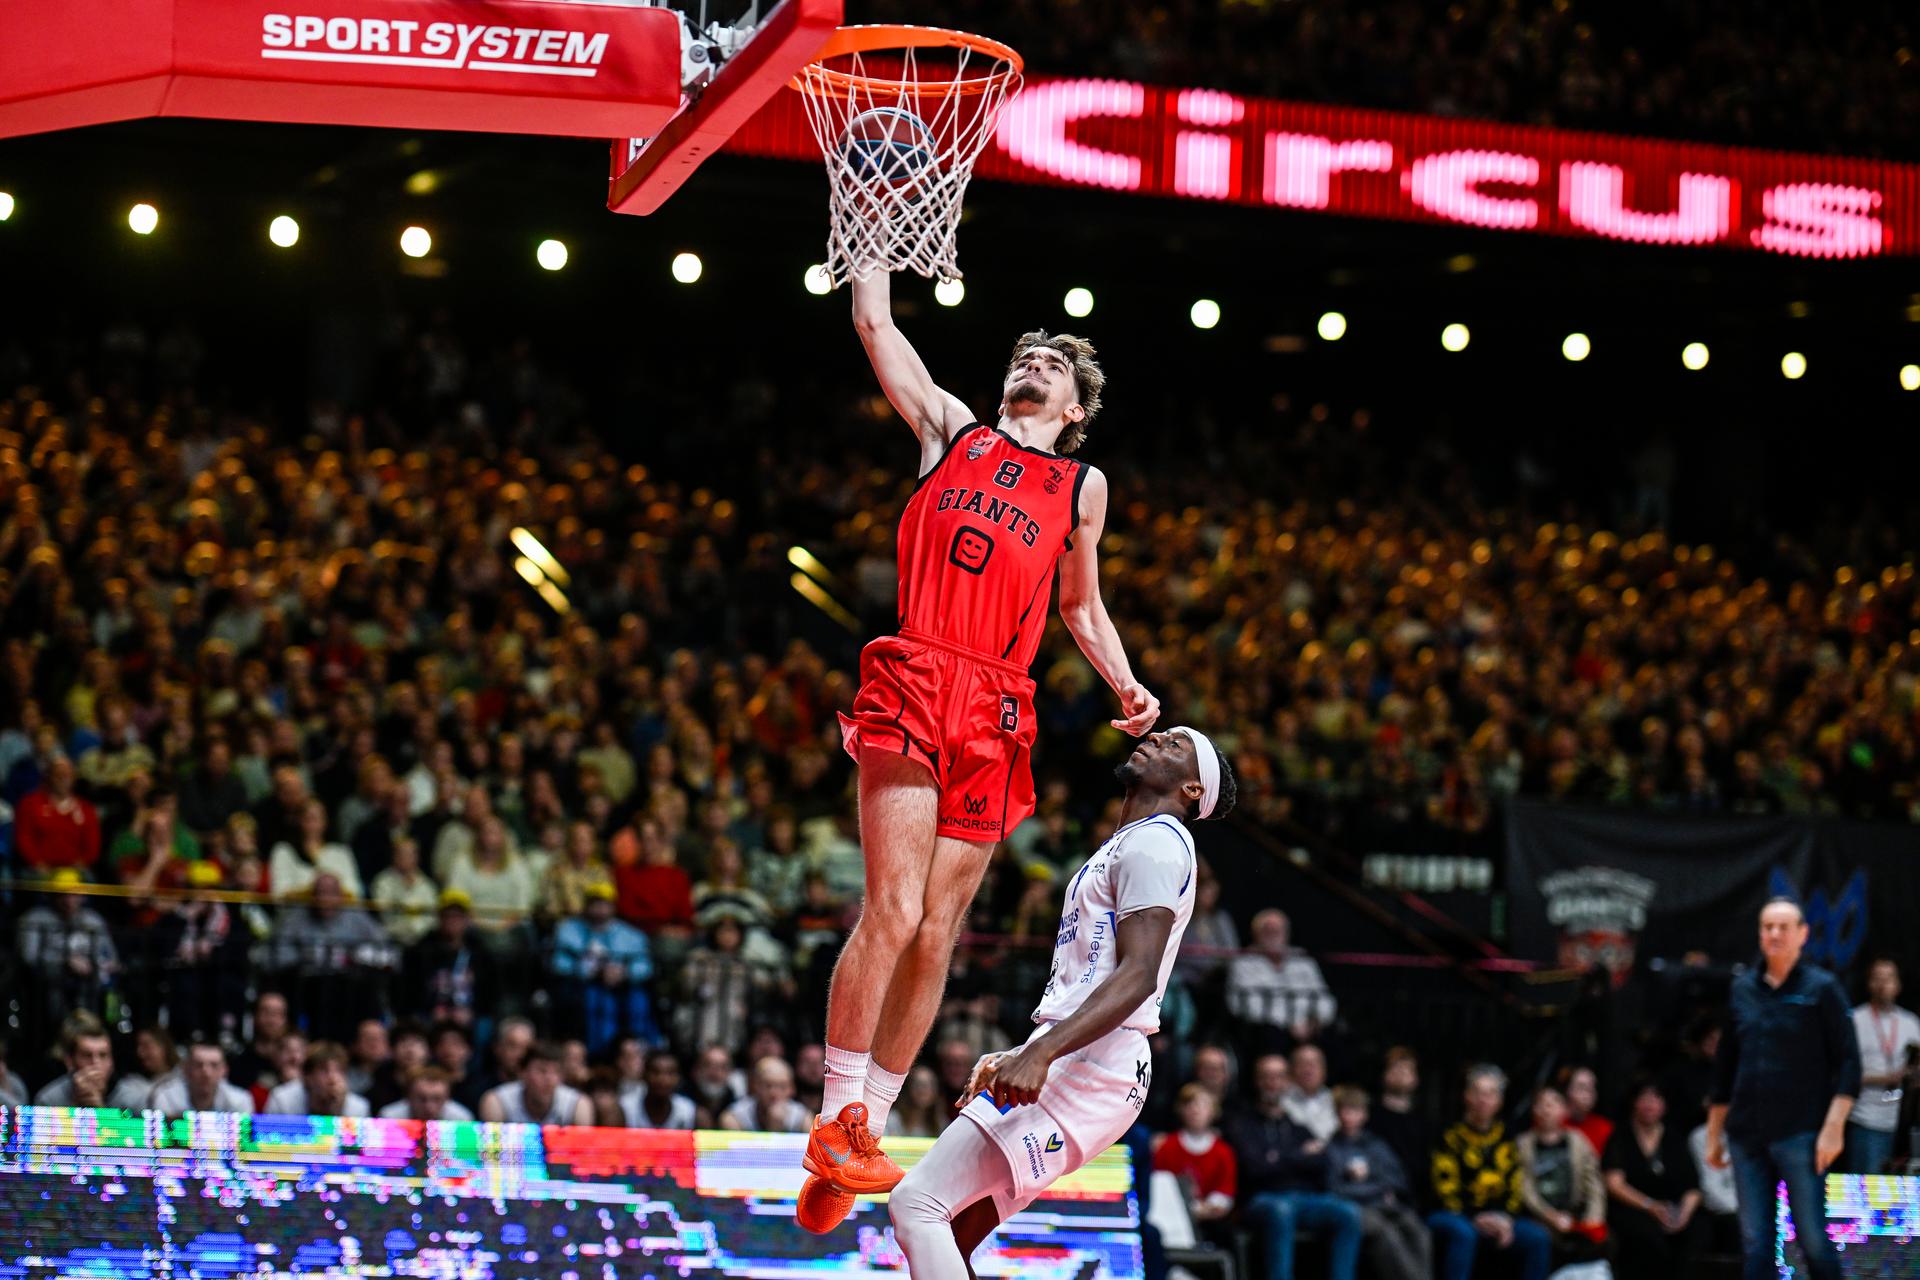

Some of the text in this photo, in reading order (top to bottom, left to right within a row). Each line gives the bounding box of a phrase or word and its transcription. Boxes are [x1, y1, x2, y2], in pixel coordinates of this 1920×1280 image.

[996, 78, 1889, 259] Circus
[993, 459, 1025, 490] 8
[936, 487, 1041, 549] GIANTS
[1000, 694, 1020, 734] 8
[1022, 1135, 1040, 1180] Keulemans
